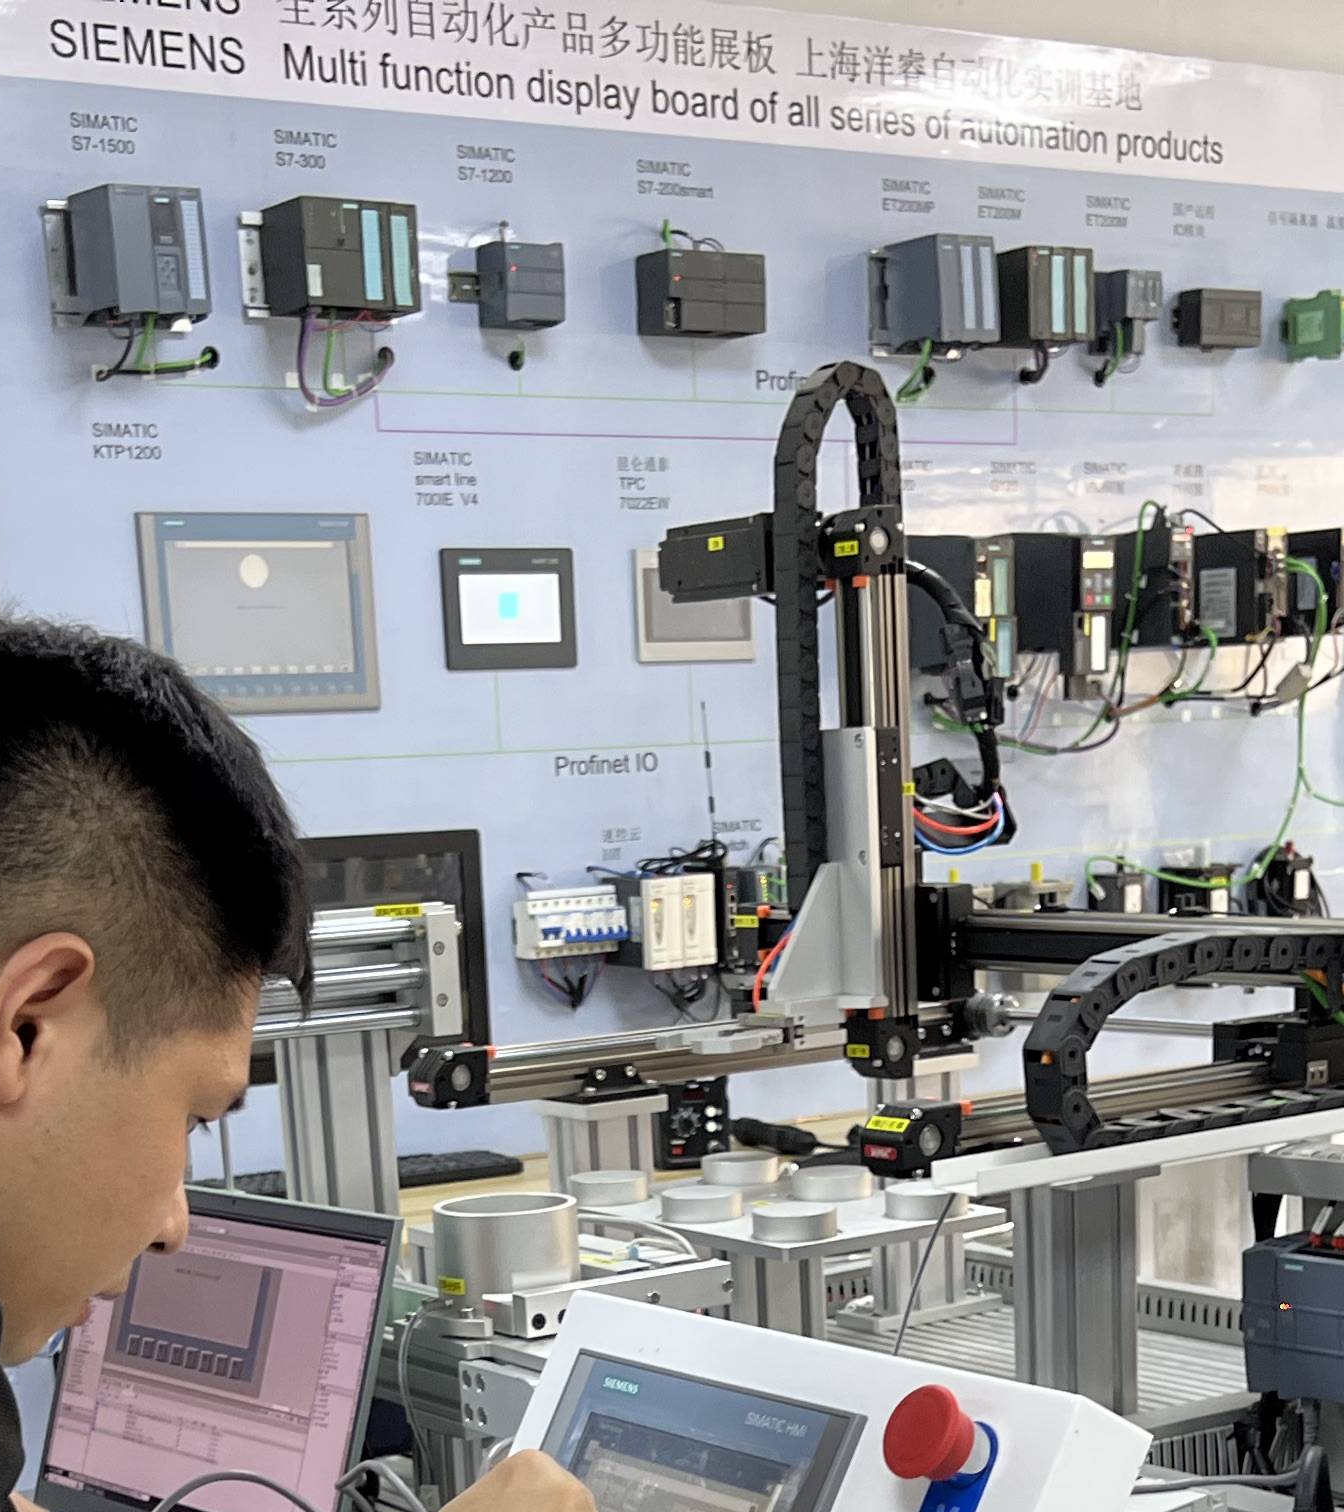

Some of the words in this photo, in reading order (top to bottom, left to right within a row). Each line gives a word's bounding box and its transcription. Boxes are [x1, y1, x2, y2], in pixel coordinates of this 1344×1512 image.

[278, 0, 778, 76] 全系列自动化产品多功能展板
[49, 18, 246, 75] SIEMENS
[283, 43, 367, 89] Multi
[379, 53, 515, 100] function
[527, 69, 640, 121] display
[650, 79, 739, 122] board
[749, 92, 779, 125] of
[787, 95, 820, 129] all
[829, 102, 916, 138] series
[924, 110, 953, 140] of
[958, 117, 1108, 154] automation
[1116, 130, 1224, 164] products
[69, 111, 138, 132] SIMATIC
[71, 135, 136, 155] S7-1500
[273, 129, 338, 148] SIMATIC
[275, 151, 326, 169] S7-300
[456, 144, 516, 163] SIMATIC
[457, 166, 513, 183] S7-1200
[635, 159, 692, 177] SIMATIC
[881, 178, 932, 195] SIMATIC
[977, 185, 1026, 202] SIMATIC
[1086, 194, 1131, 211] SIMATIC
[91, 421, 159, 439] SIMATIC
[92, 443, 162, 460] KTP1200
[413, 451, 473, 466] SIMATIC
[454, 472, 477, 486] line
[618, 477, 646, 491] TPC
[554, 754, 631, 777] Profinet
[635, 752, 659, 773] IO
[602, 1376, 639, 1394] SIEMENS
[743, 1411, 786, 1434] SIMATIC
[785, 1423, 809, 1439] HMI
